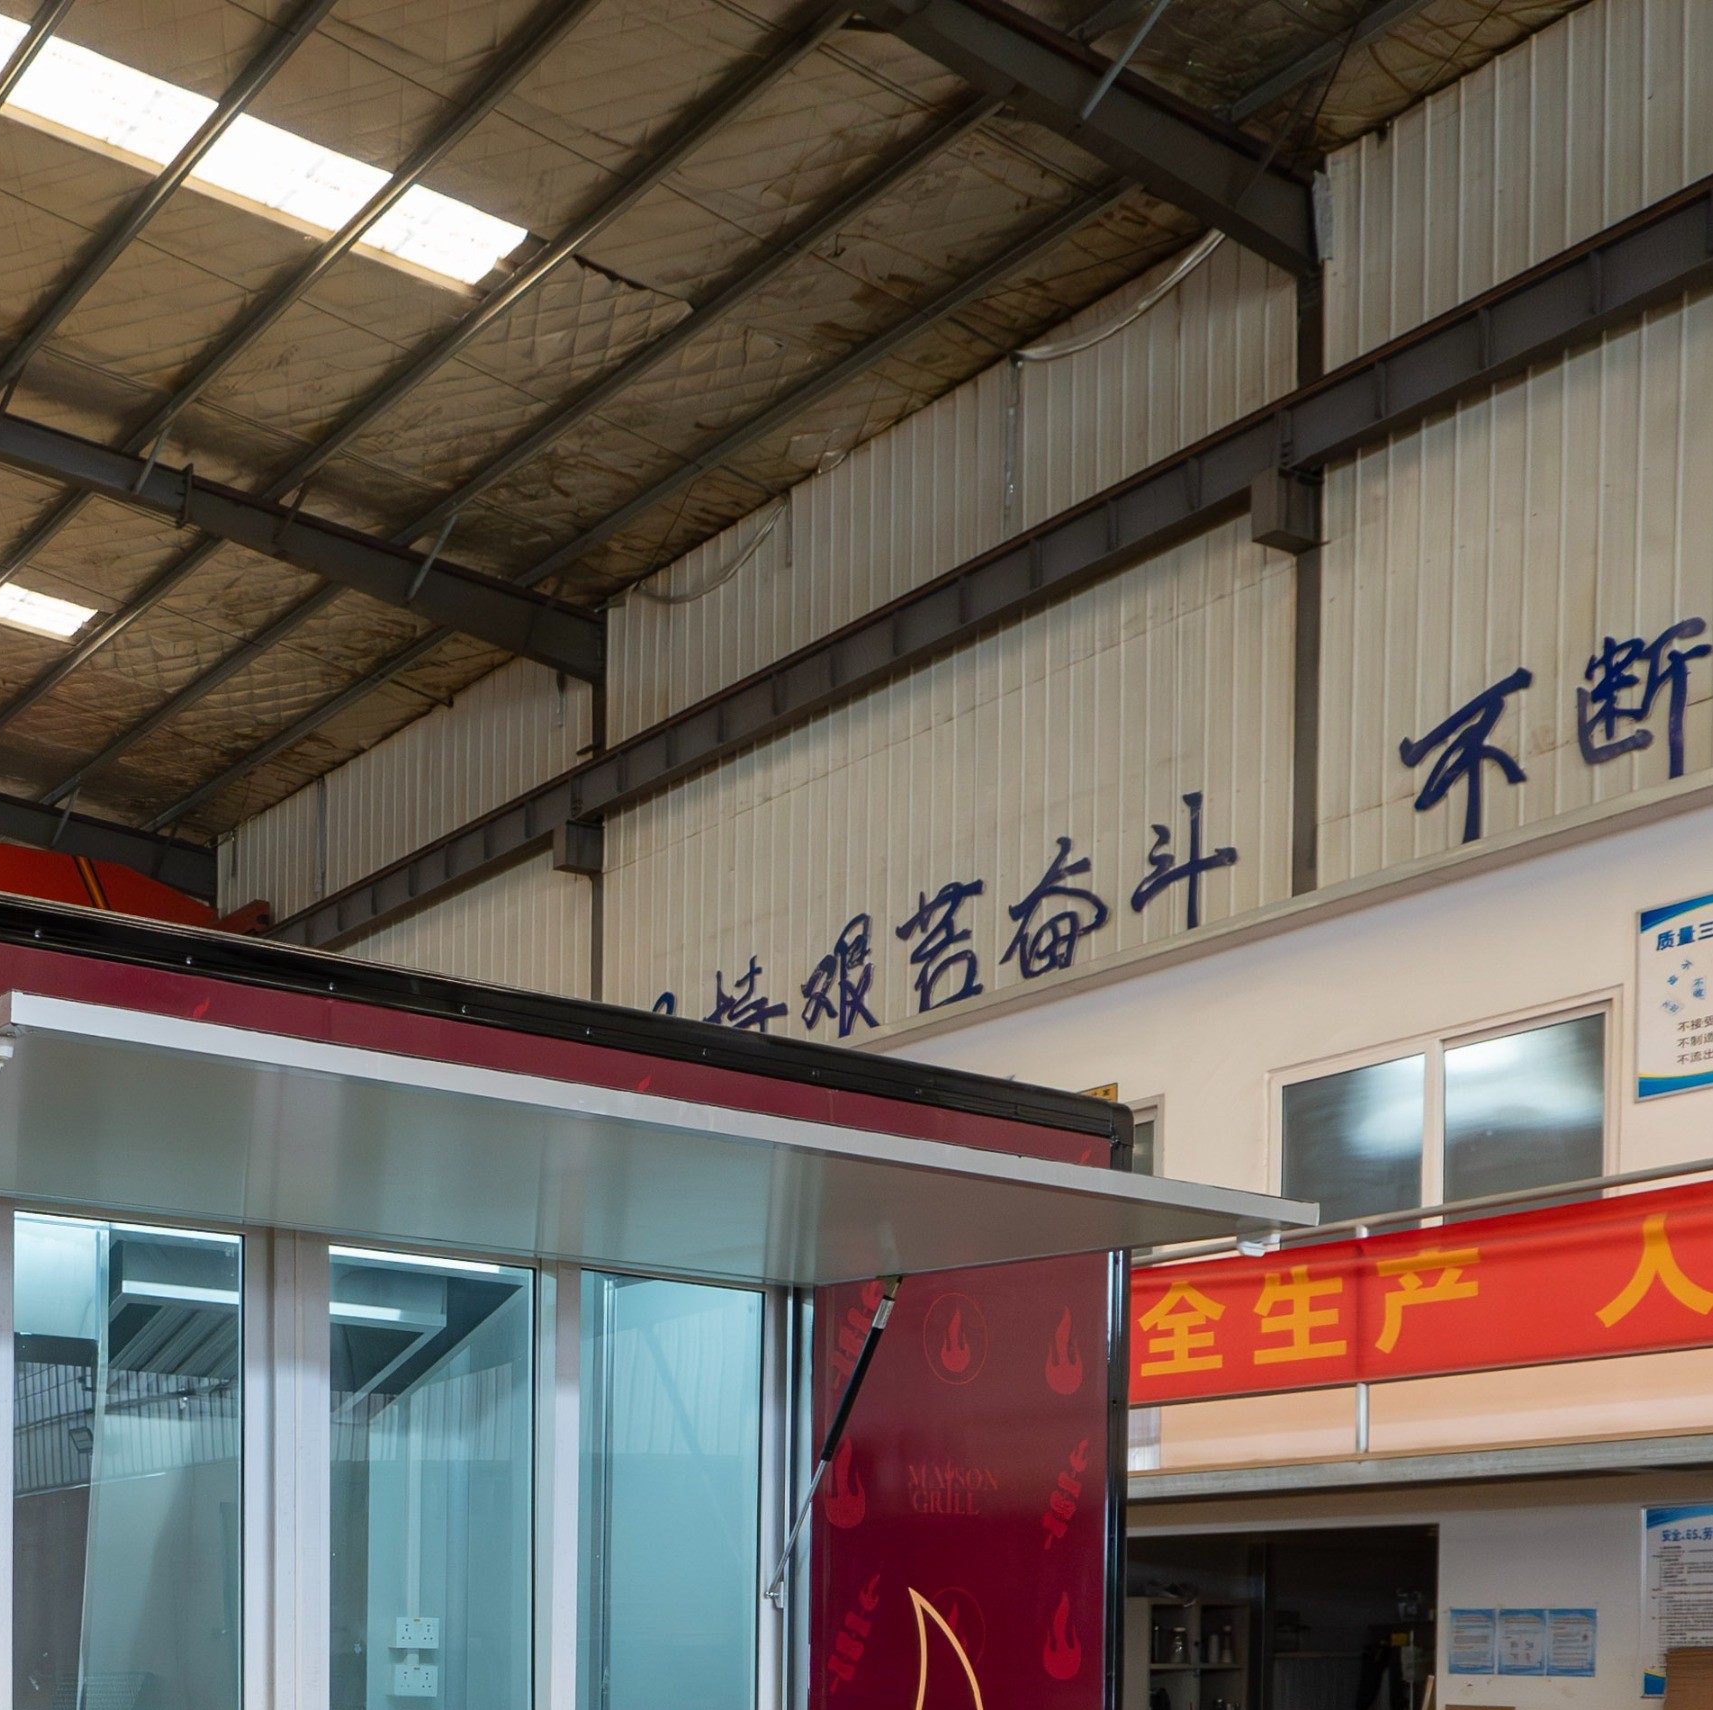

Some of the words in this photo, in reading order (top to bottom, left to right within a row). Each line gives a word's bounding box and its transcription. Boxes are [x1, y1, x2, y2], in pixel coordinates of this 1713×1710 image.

[1399, 617, 1713, 844] 不断
[1138, 1246, 1481, 1376] 全生产
[1595, 1212, 1713, 1327] 人
[908, 1459, 998, 1491] MAISON
[912, 1489, 981, 1516] GRILL
